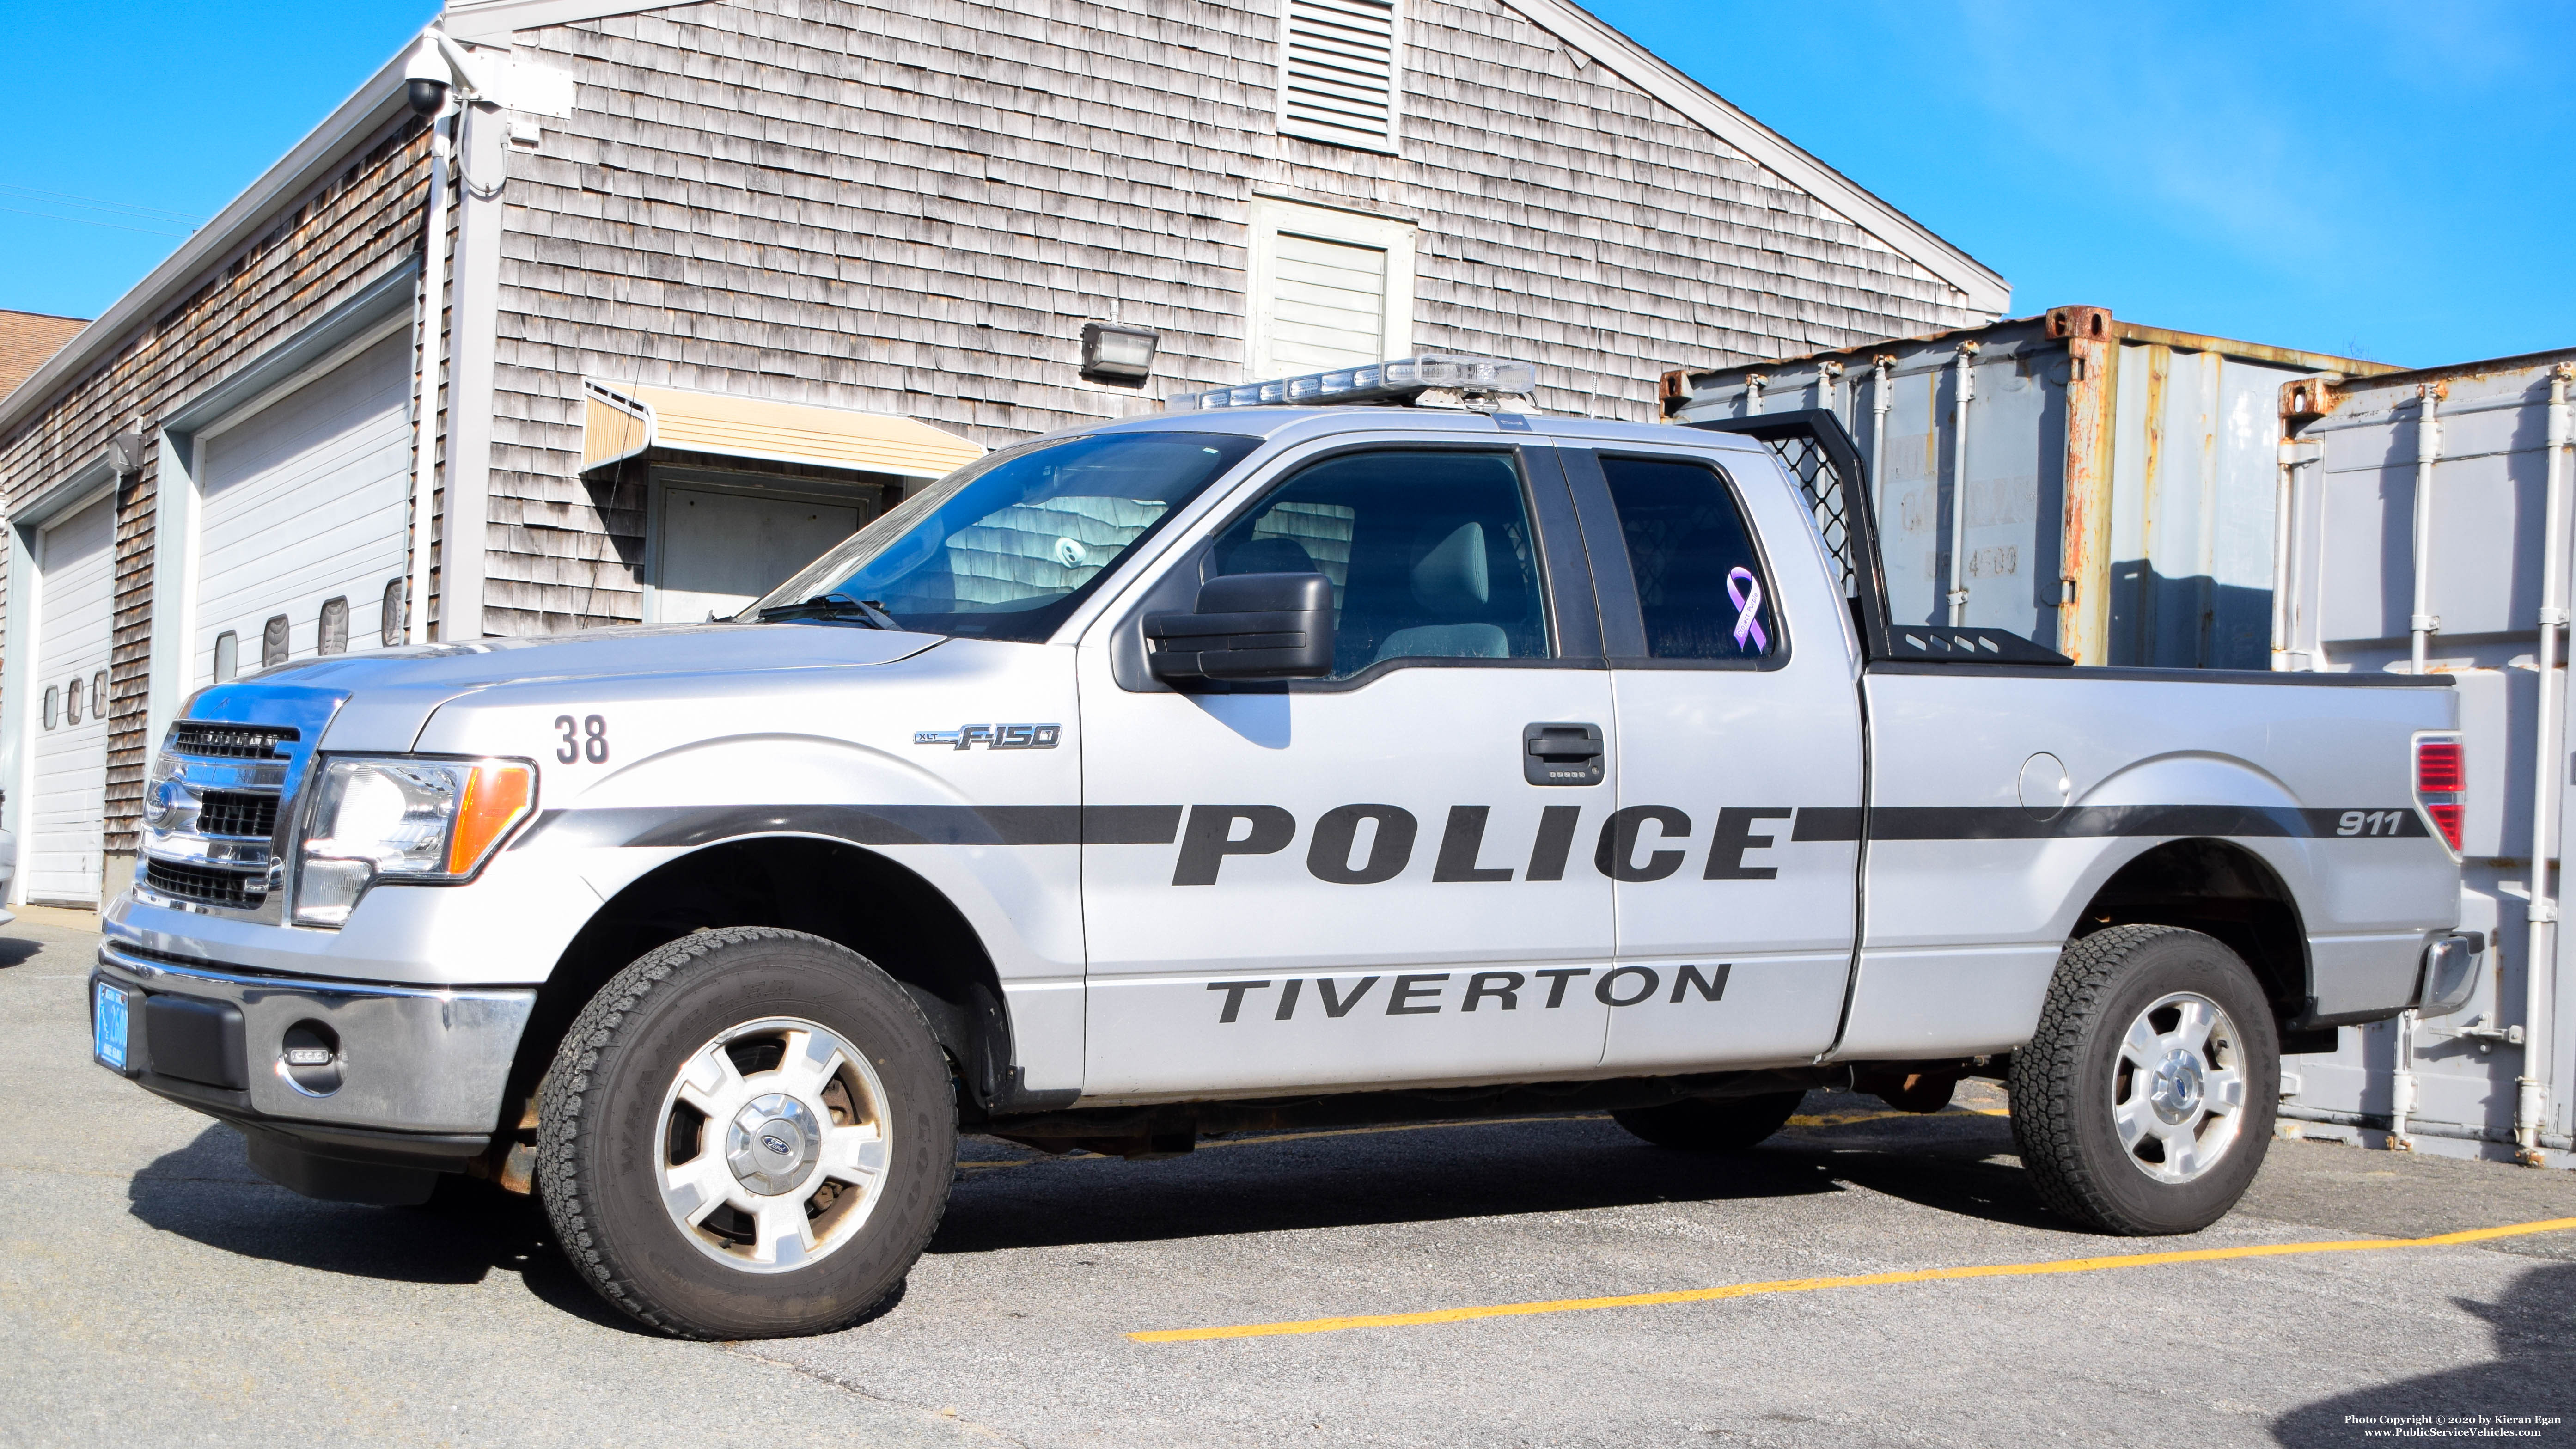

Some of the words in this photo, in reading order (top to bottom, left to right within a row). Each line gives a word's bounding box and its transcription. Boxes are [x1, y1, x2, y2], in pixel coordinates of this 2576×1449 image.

[1737, 613, 1750, 636] Project
[1747, 593, 1758, 612] Purple
[555, 714, 610, 764] 38
[953, 723, 1063, 751] F-150
[1172, 803, 1793, 886] POLICE
[2336, 811, 2402, 835] 911
[1206, 963, 1732, 1023] TIVERTON
